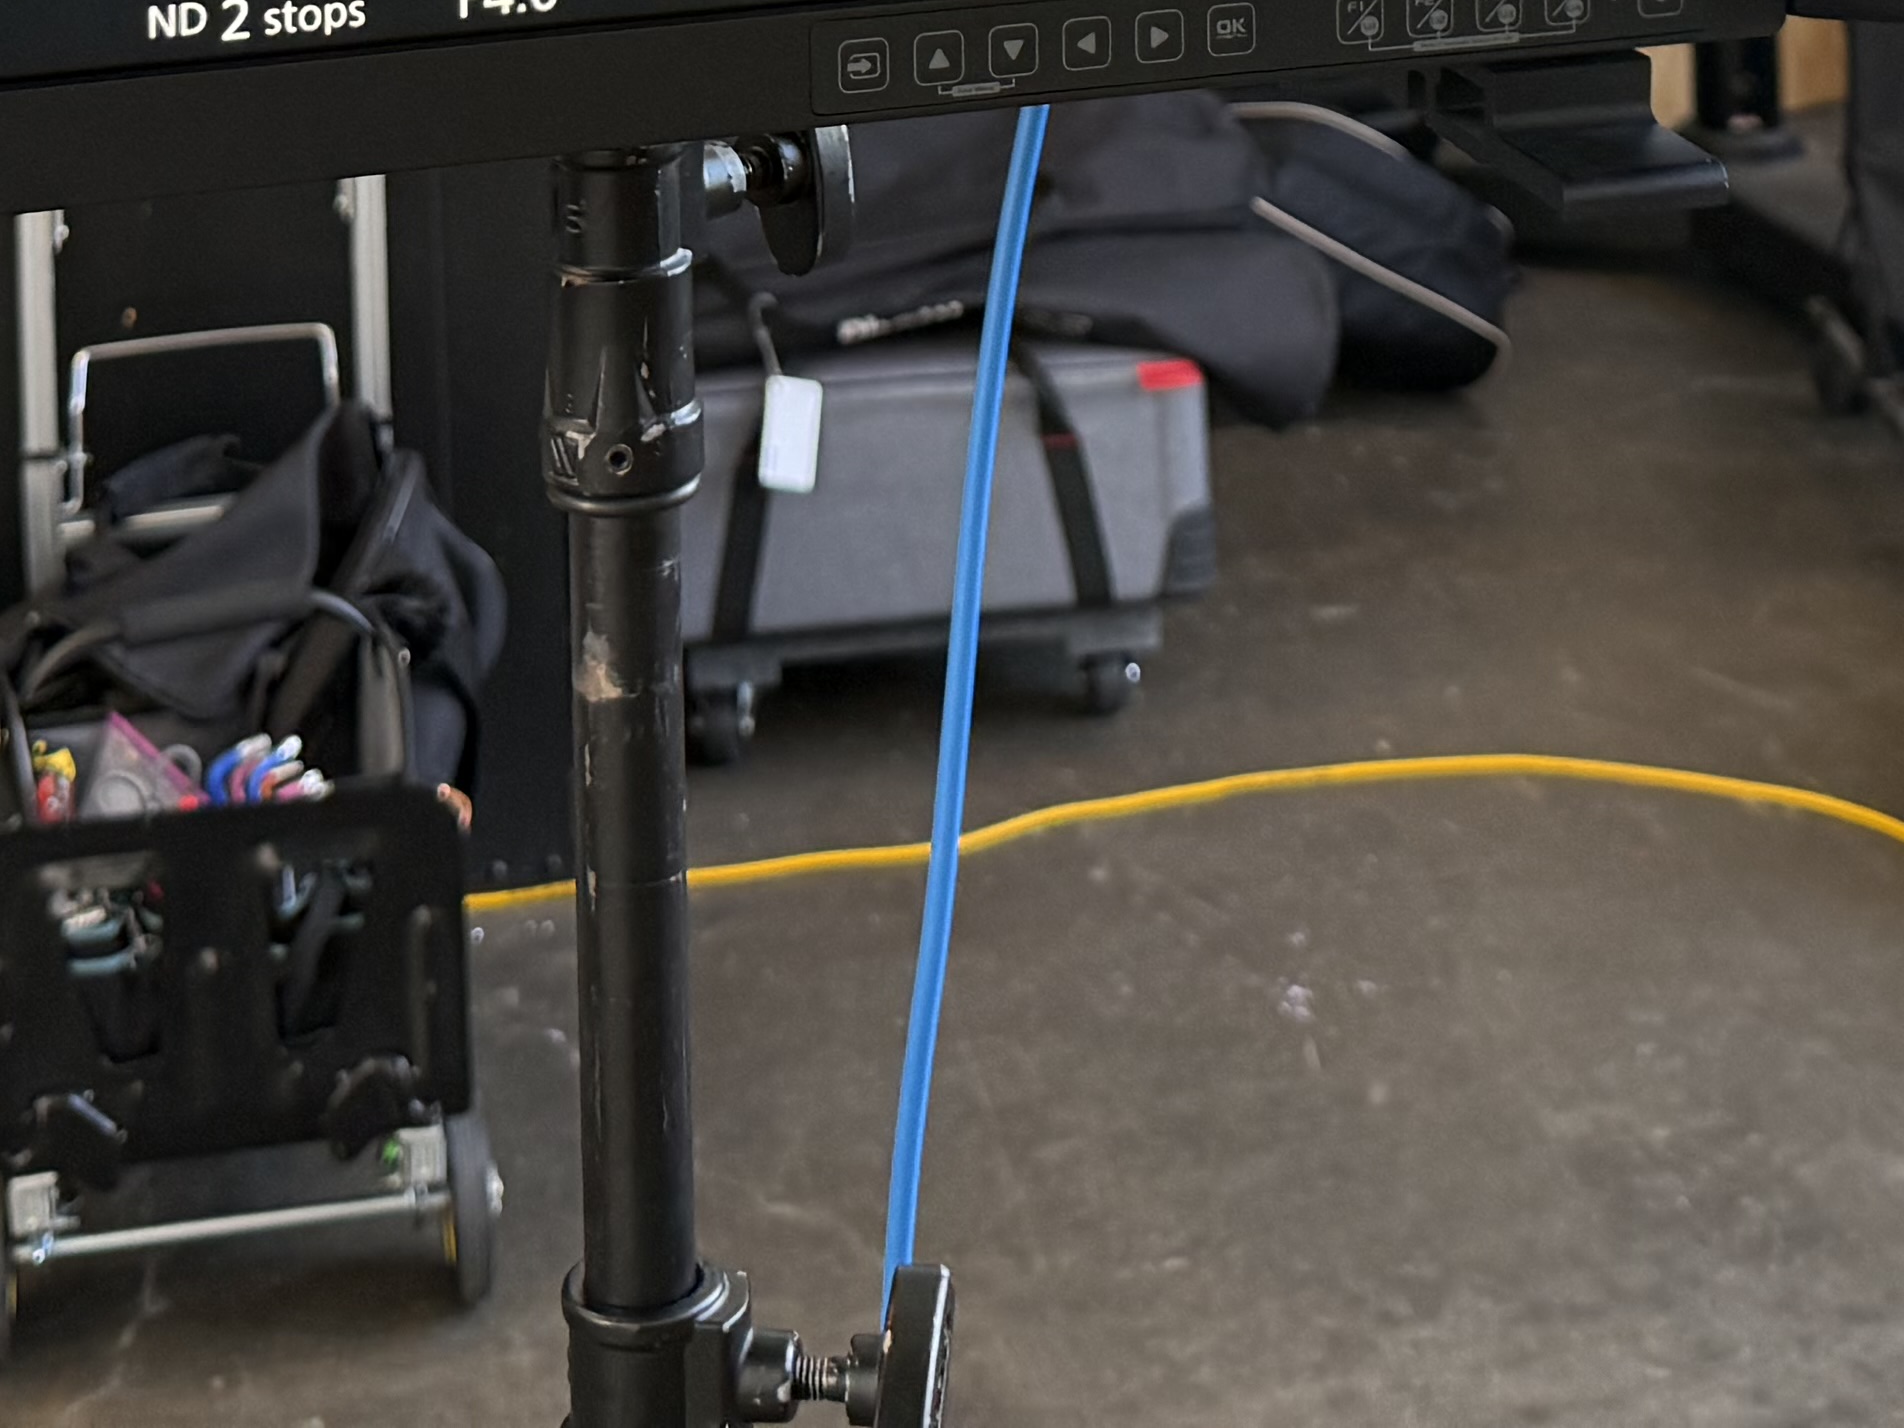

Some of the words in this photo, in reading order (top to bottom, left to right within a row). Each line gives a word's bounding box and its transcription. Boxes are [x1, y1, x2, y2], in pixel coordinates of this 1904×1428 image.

[1346, 0, 1365, 13] F1
[147, 1, 208, 40] ND
[263, 0, 367, 36] stops
[1216, 17, 1246, 34] OK
